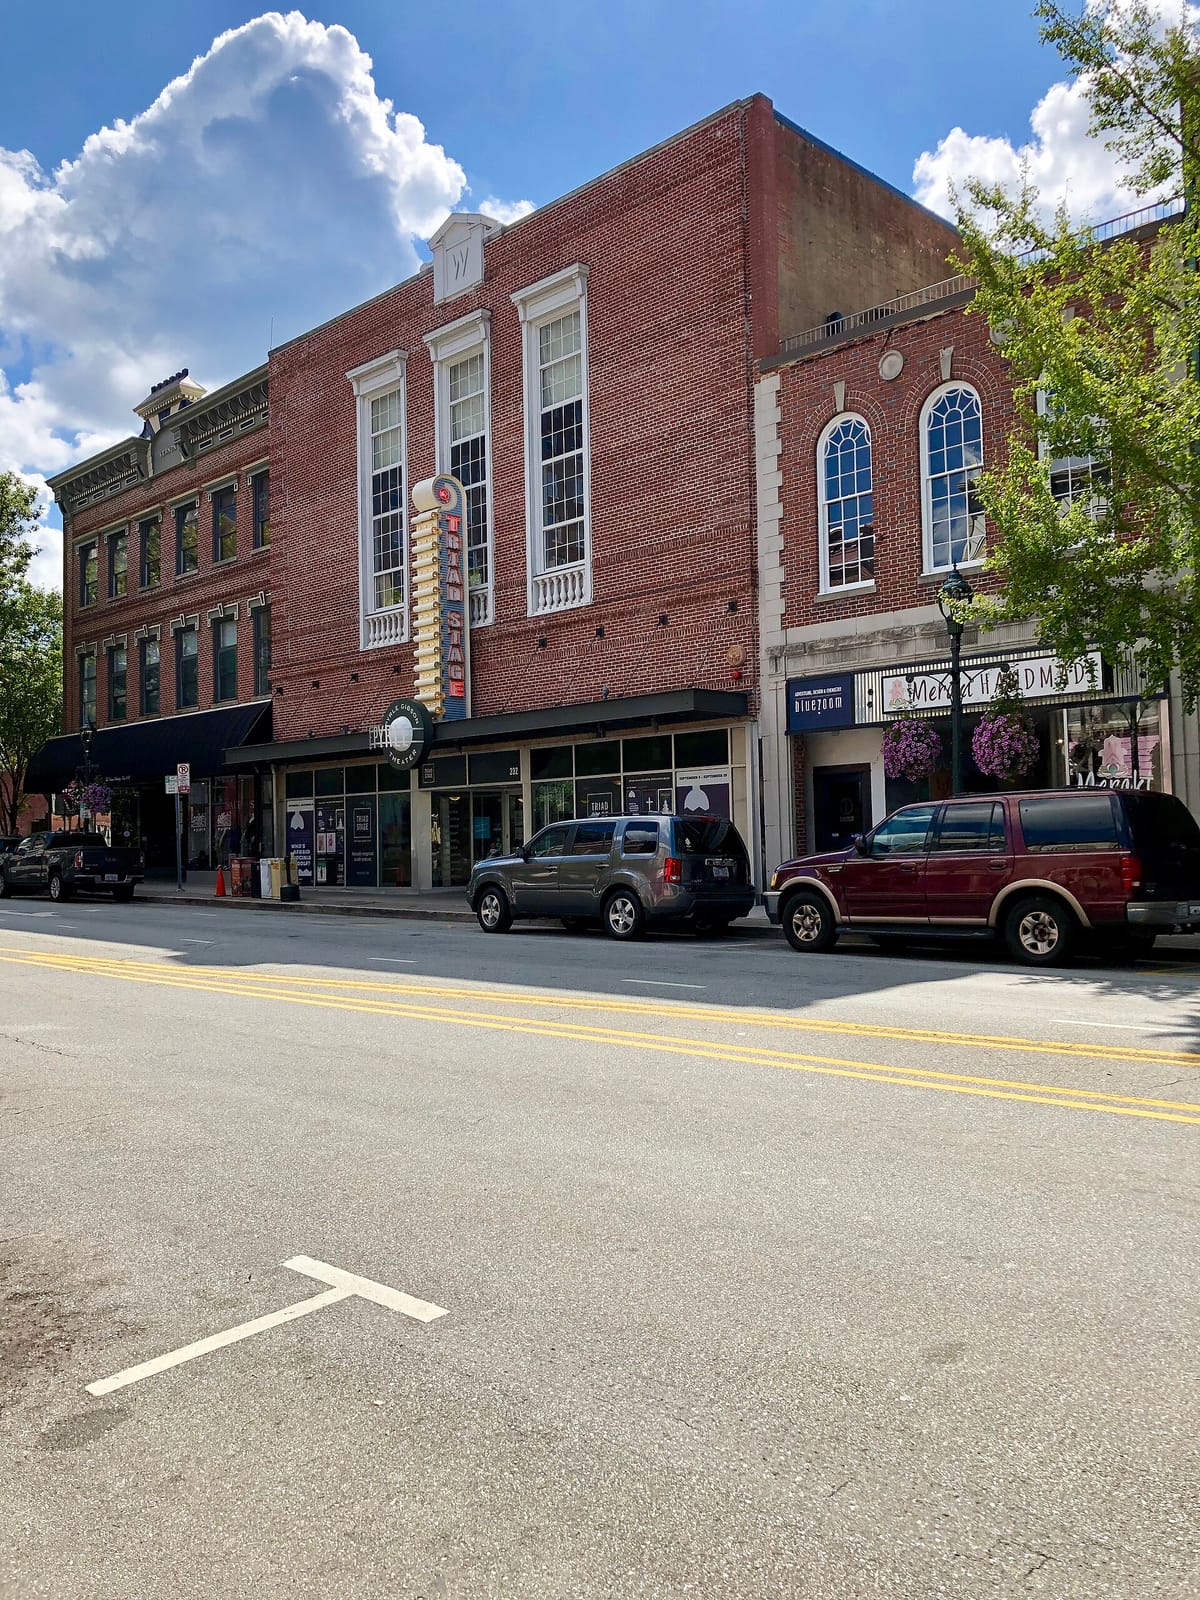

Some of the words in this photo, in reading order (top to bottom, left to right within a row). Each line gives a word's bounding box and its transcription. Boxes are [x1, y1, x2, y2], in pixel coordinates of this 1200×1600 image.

[452, 247, 470, 281] W
[445, 514, 464, 601] TRIAD
[447, 610, 465, 697] STAGE
[401, 703, 421, 725] GIBSON
[388, 748, 417, 765] THEATER
[591, 801, 608, 811] TRIAD
